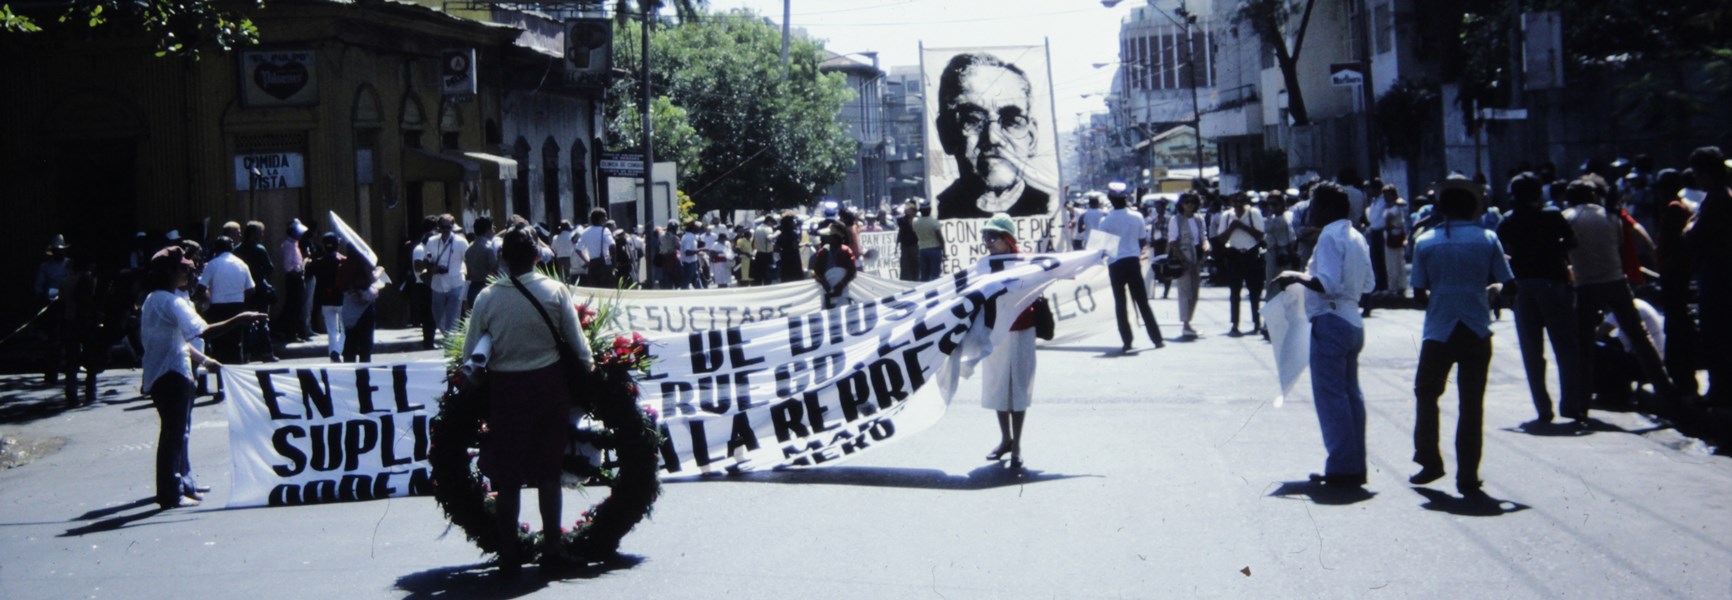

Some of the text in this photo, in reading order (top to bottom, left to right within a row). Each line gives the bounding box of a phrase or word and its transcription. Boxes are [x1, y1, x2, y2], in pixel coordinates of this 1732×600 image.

[243, 154, 290, 170] COMIDA
[945, 220, 978, 243] CON
[969, 243, 988, 256] NO
[255, 366, 335, 420] EN
[355, 364, 425, 414] EL
[688, 325, 765, 375] DE
[787, 289, 918, 357] DIOS
[271, 414, 438, 478] SUPLI
[660, 351, 846, 418] RUEGO
[689, 411, 761, 468] LA
